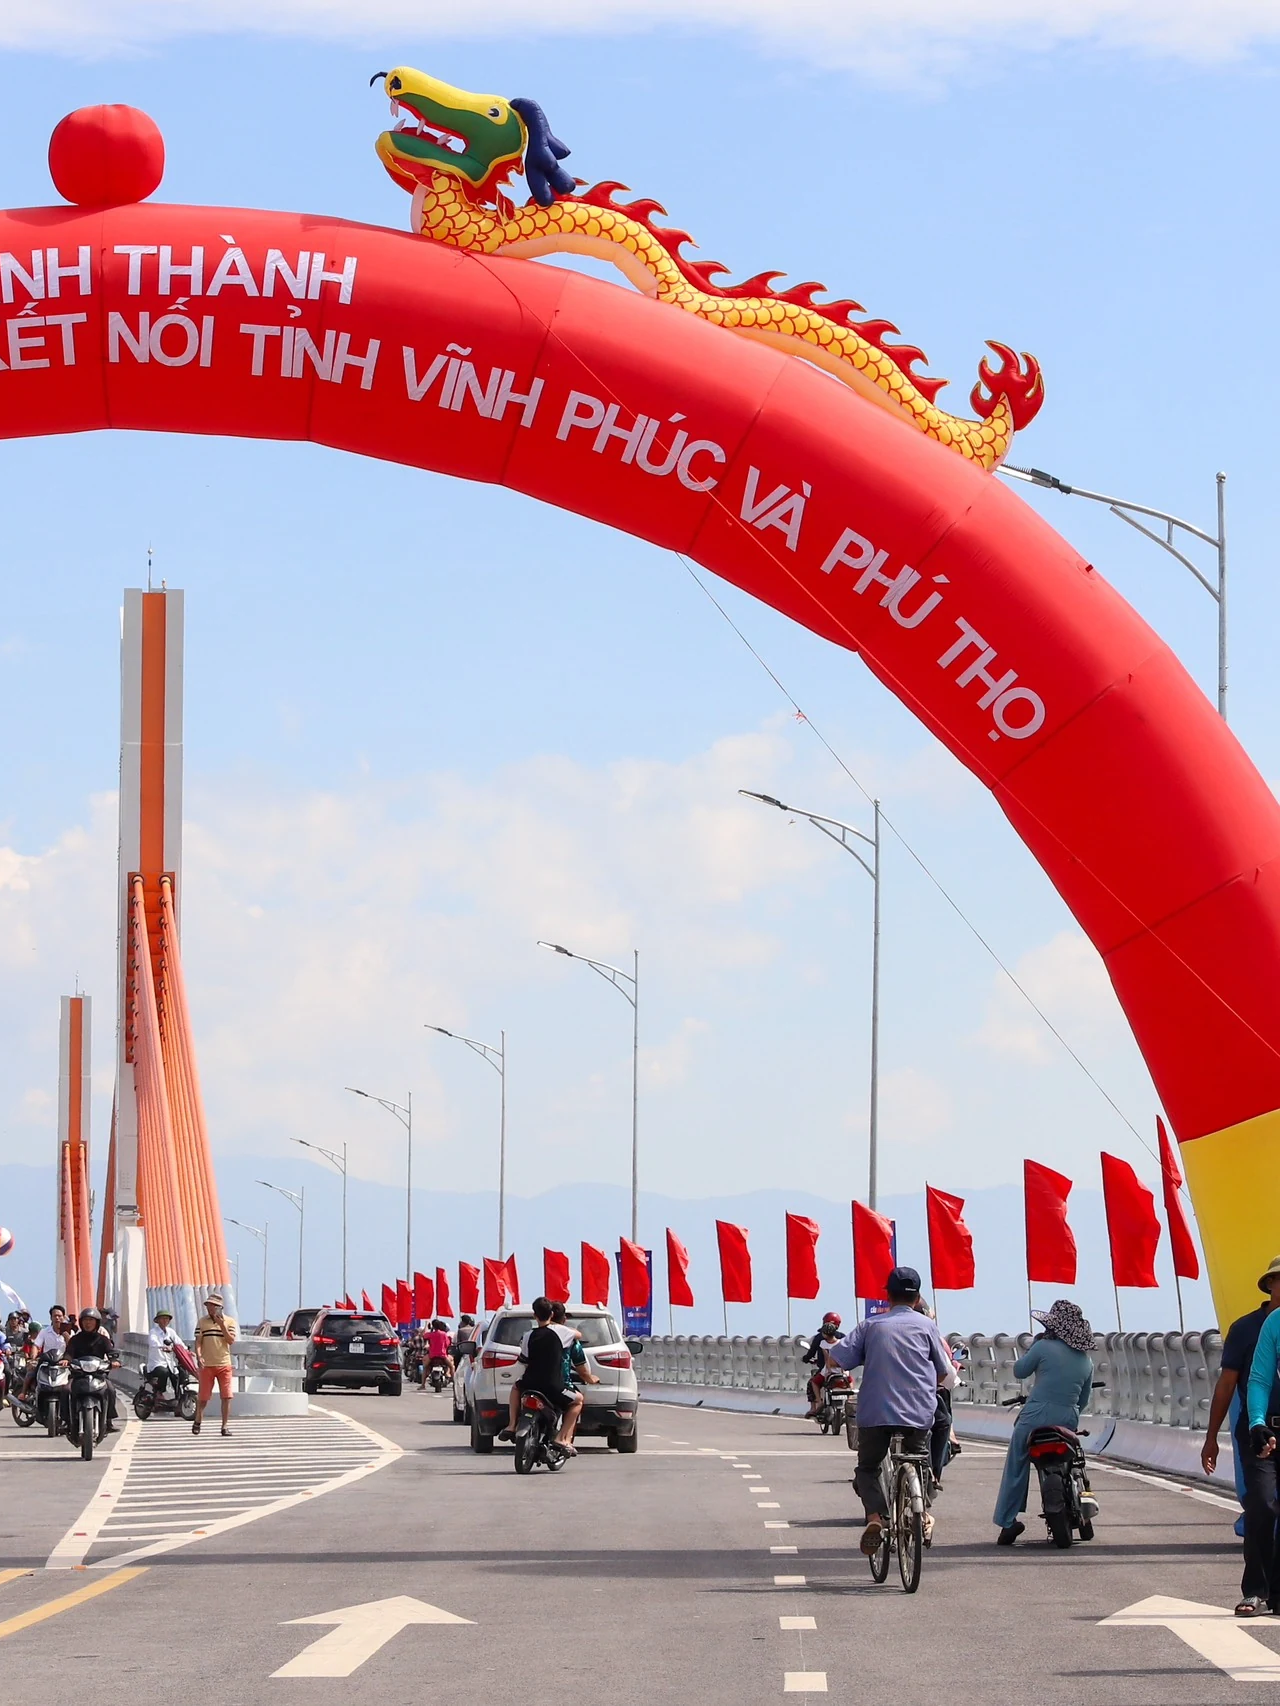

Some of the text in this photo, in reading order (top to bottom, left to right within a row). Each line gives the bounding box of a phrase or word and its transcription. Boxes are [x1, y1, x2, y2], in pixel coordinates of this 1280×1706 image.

[113, 234, 358, 305] THÀNH
[108, 297, 215, 367] NỐI
[239, 304, 381, 390] TỈNH
[402, 342, 545, 428] VĨNH
[556, 390, 726, 492] PHÚC
[740, 465, 812, 552] VÀ
[820, 527, 950, 629] PHÚ
[937, 616, 1046, 742] THỌ
